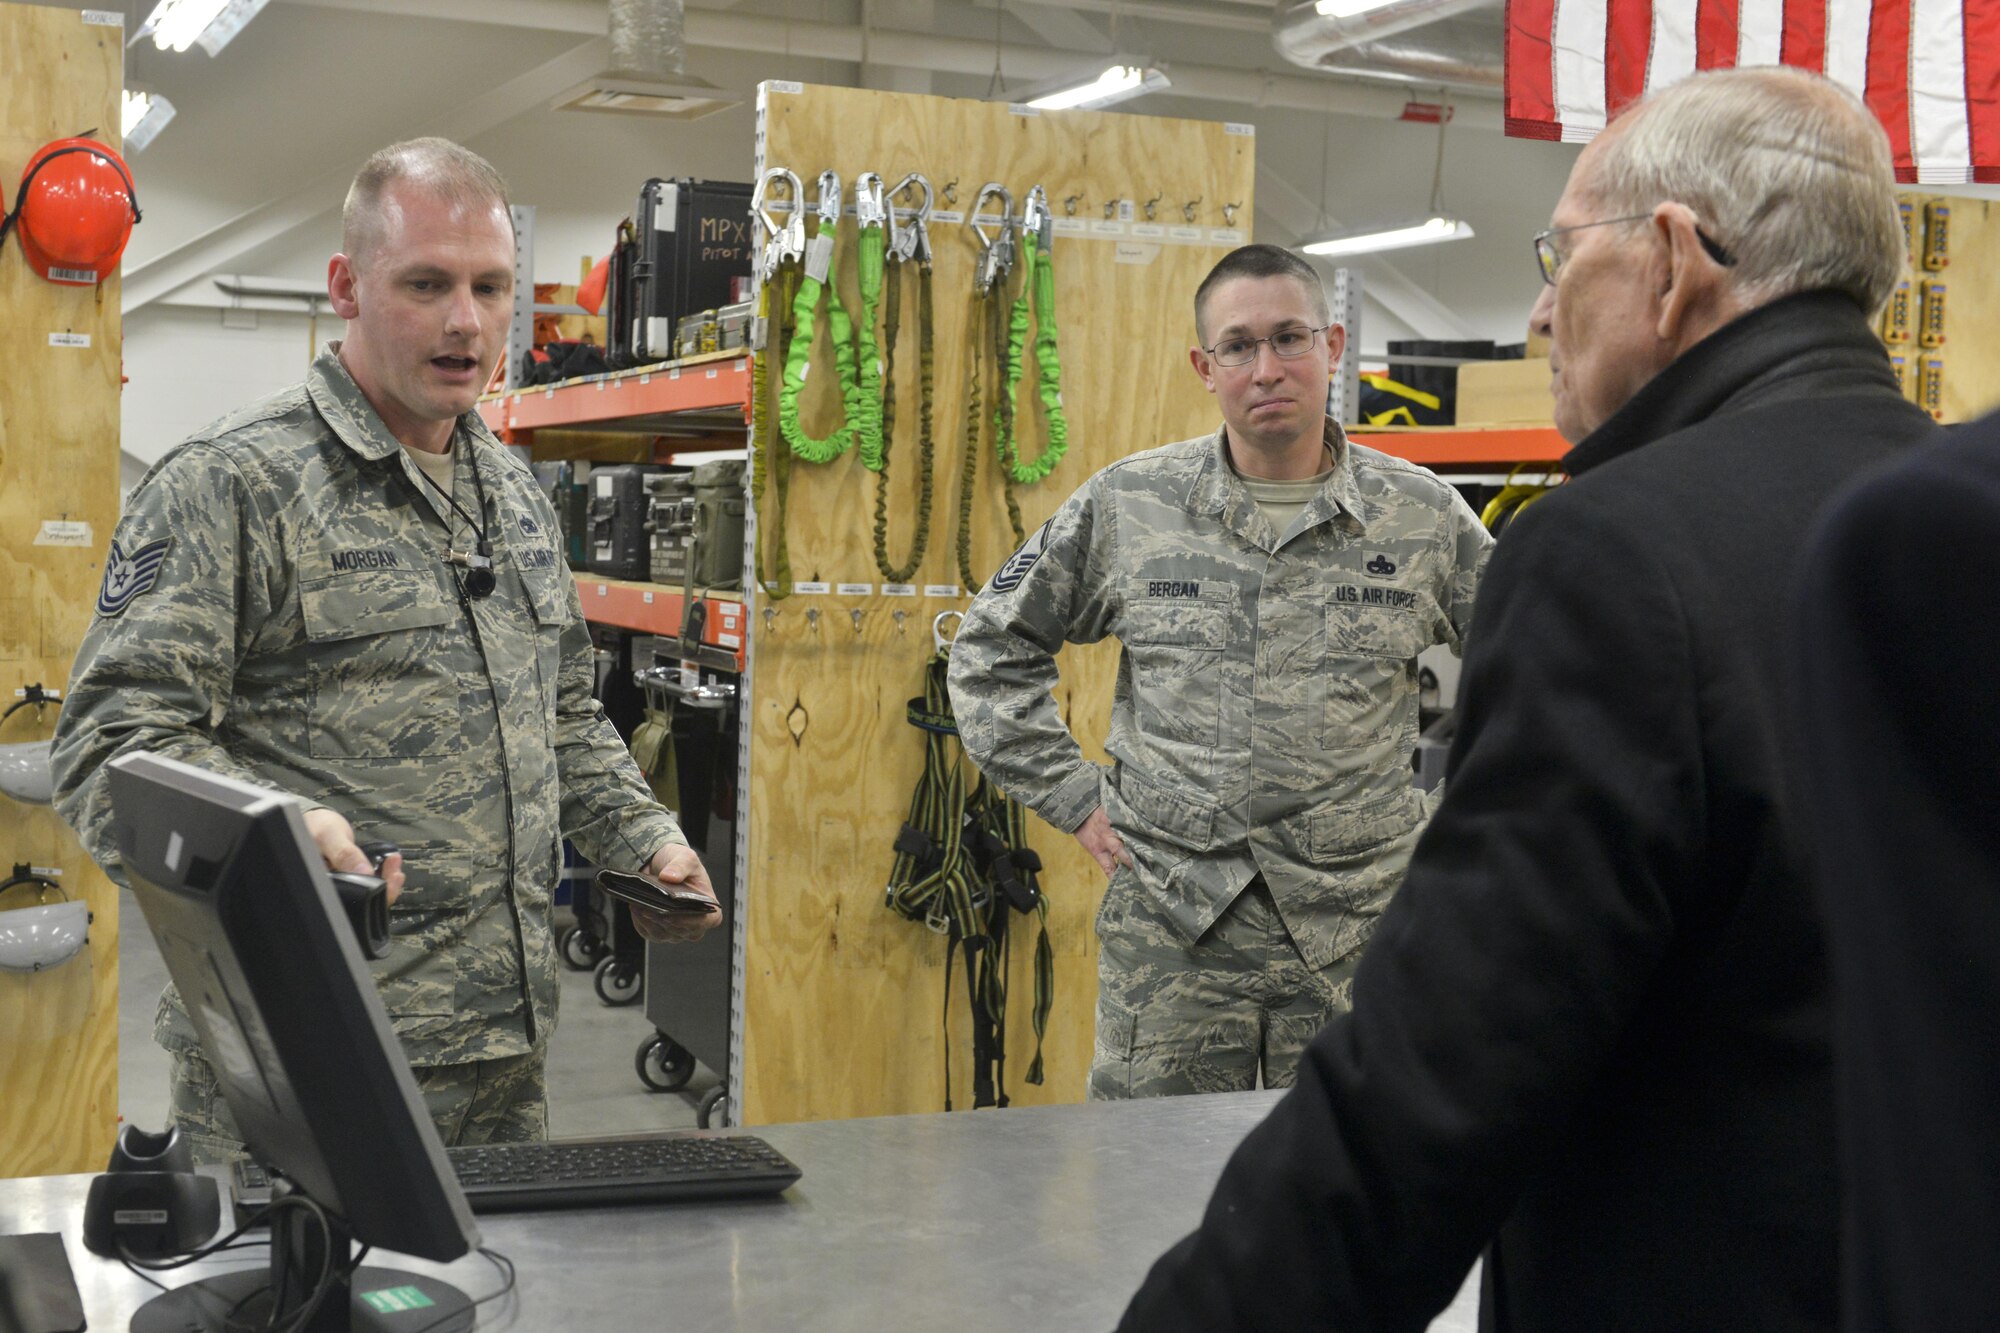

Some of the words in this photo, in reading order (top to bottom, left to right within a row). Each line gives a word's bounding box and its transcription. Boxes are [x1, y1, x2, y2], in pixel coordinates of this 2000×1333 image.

[700, 217, 746, 244] MPX
[702, 247, 741, 262] PITOT
[331, 550, 399, 572] MORGAN
[1148, 581, 1200, 599] BERGAN
[1362, 587, 1383, 605] AIR
[1386, 589, 1417, 609] FORCE
